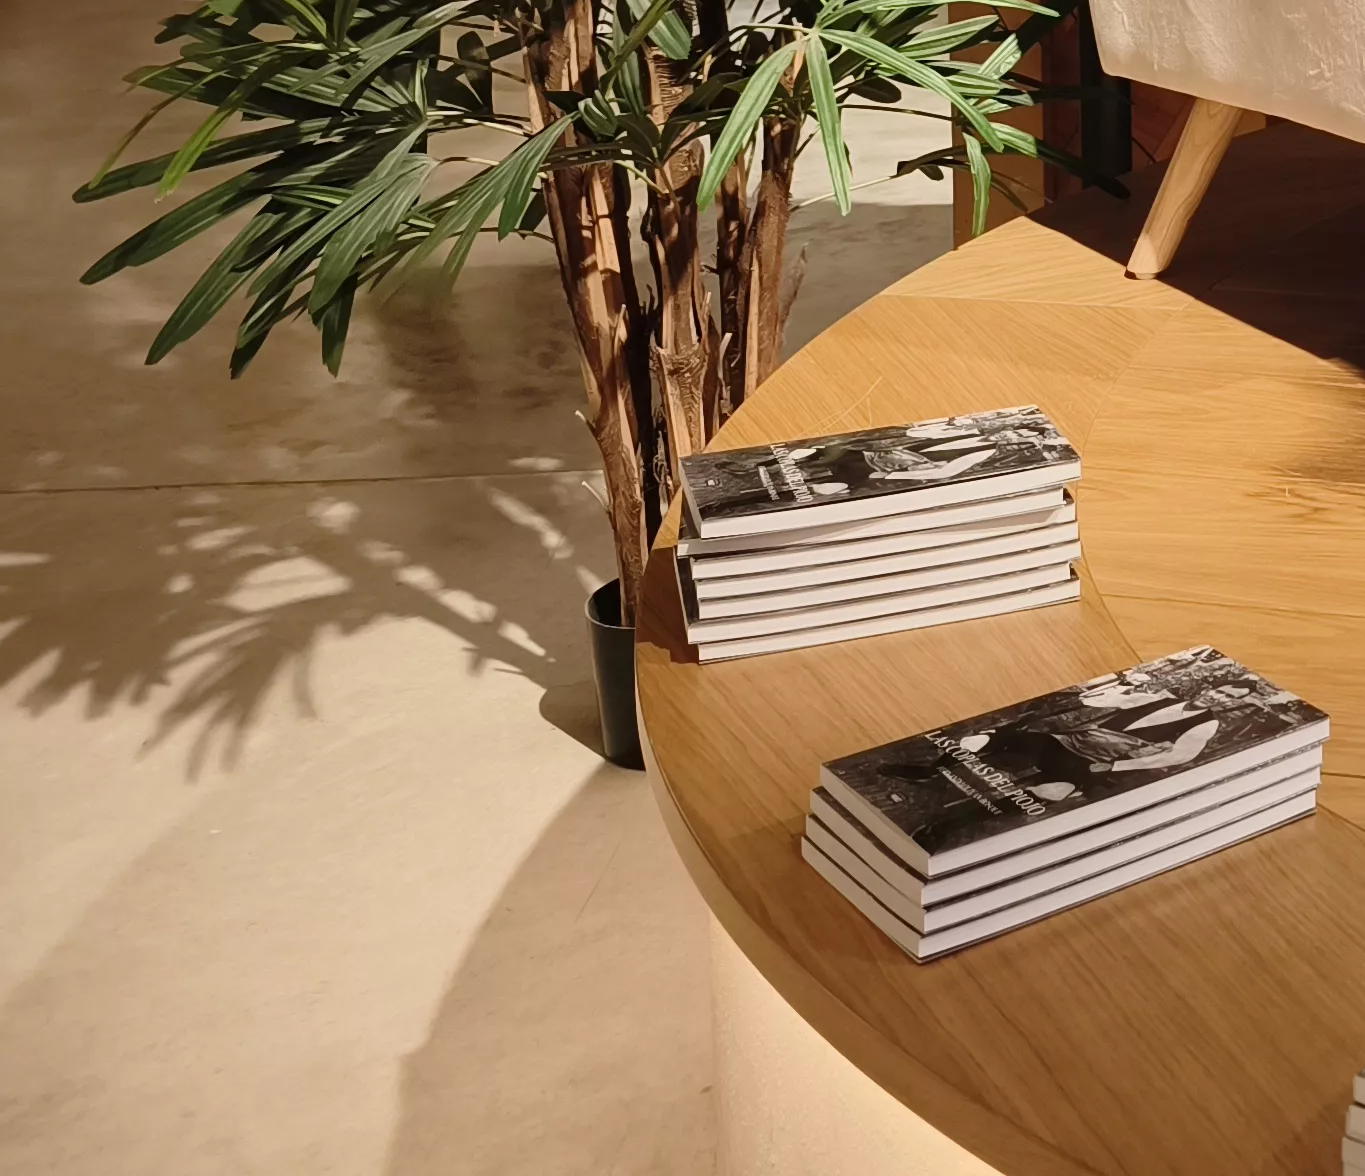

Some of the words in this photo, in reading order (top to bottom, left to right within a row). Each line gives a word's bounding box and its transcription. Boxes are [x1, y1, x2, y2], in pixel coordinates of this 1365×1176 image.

[925, 730, 955, 750] LAS
[945, 741, 994, 776] COPLAS
[984, 772, 1014, 797] DEL
[1010, 788, 1046, 816] PIOJO
